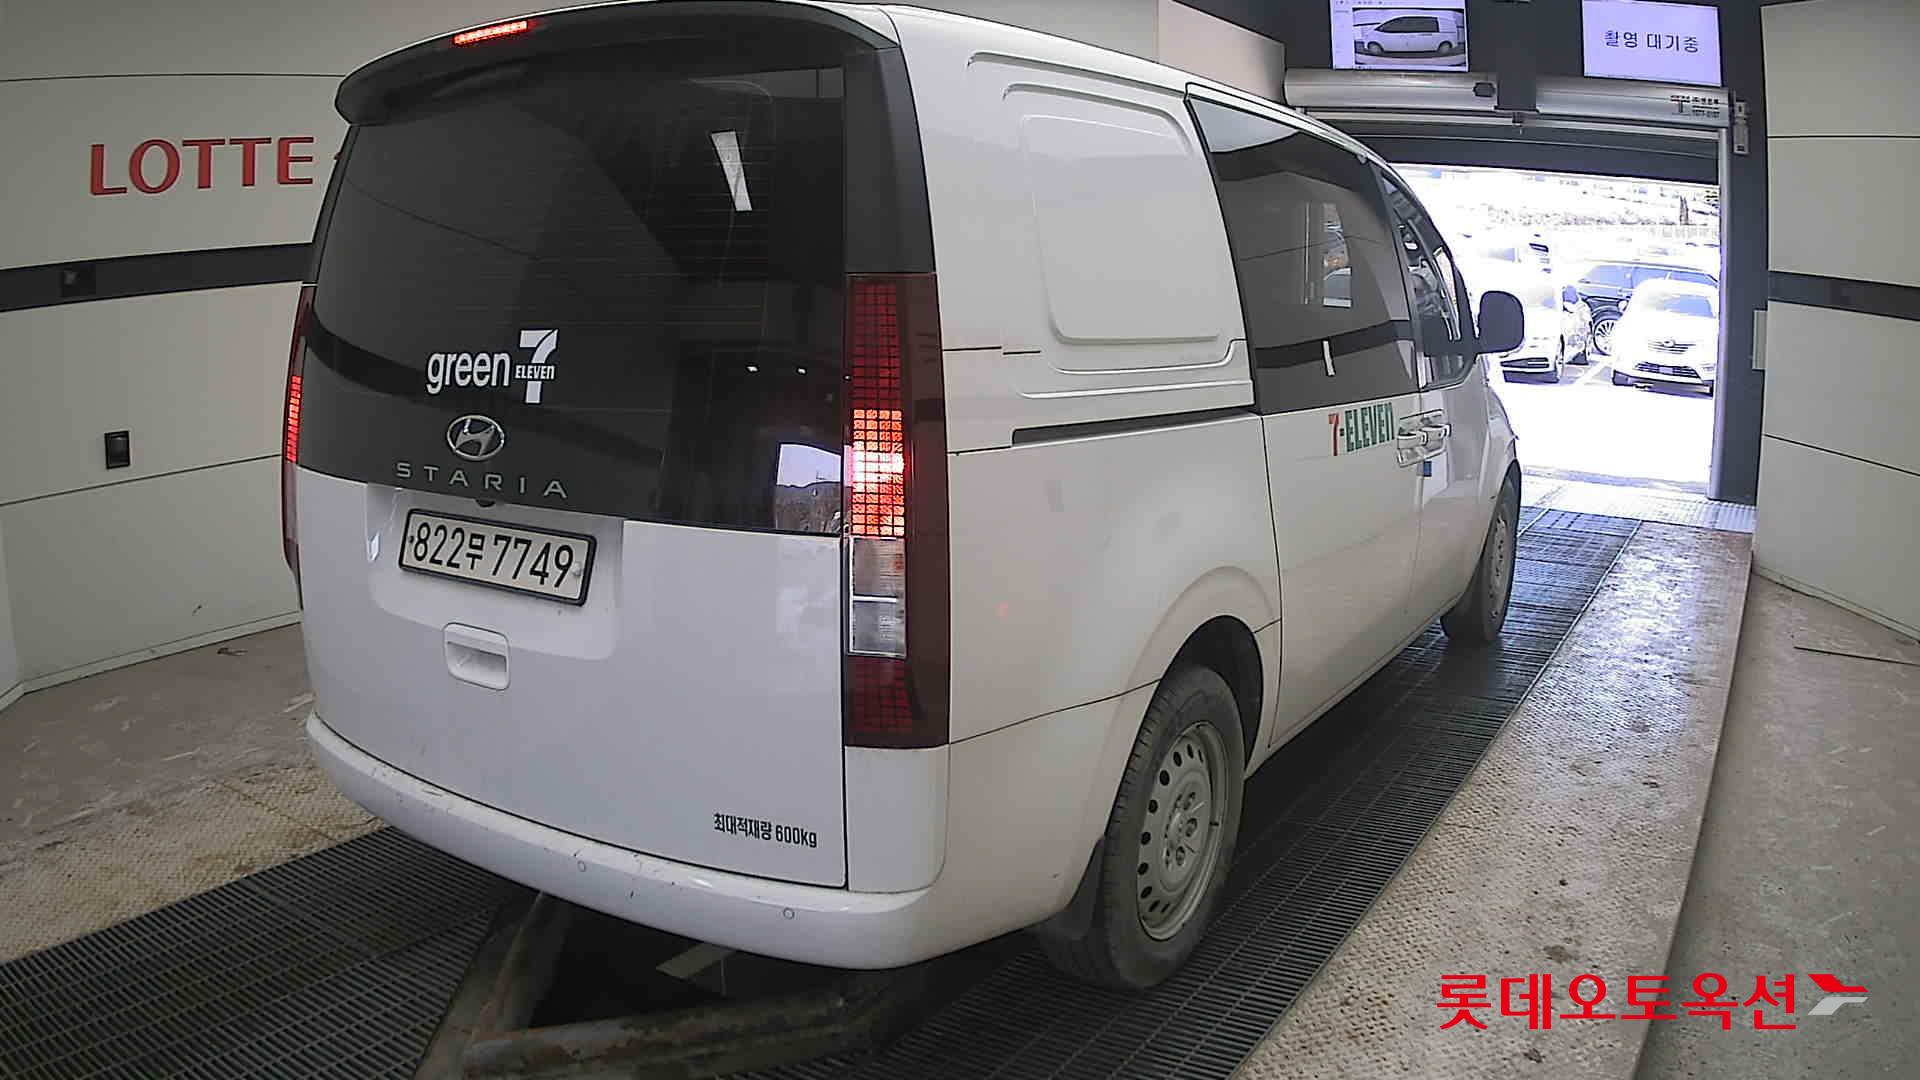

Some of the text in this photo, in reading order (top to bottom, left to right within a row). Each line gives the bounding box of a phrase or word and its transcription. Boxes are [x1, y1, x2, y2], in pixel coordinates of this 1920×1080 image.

[1604, 30, 1699, 53] 촬영 대기중
[90, 136, 315, 196] LOTTE
[426, 352, 511, 395] green
[519, 329, 559, 404] 7
[395, 461, 568, 499] STARIA
[713, 813, 818, 848] 최대적재량 600kg
